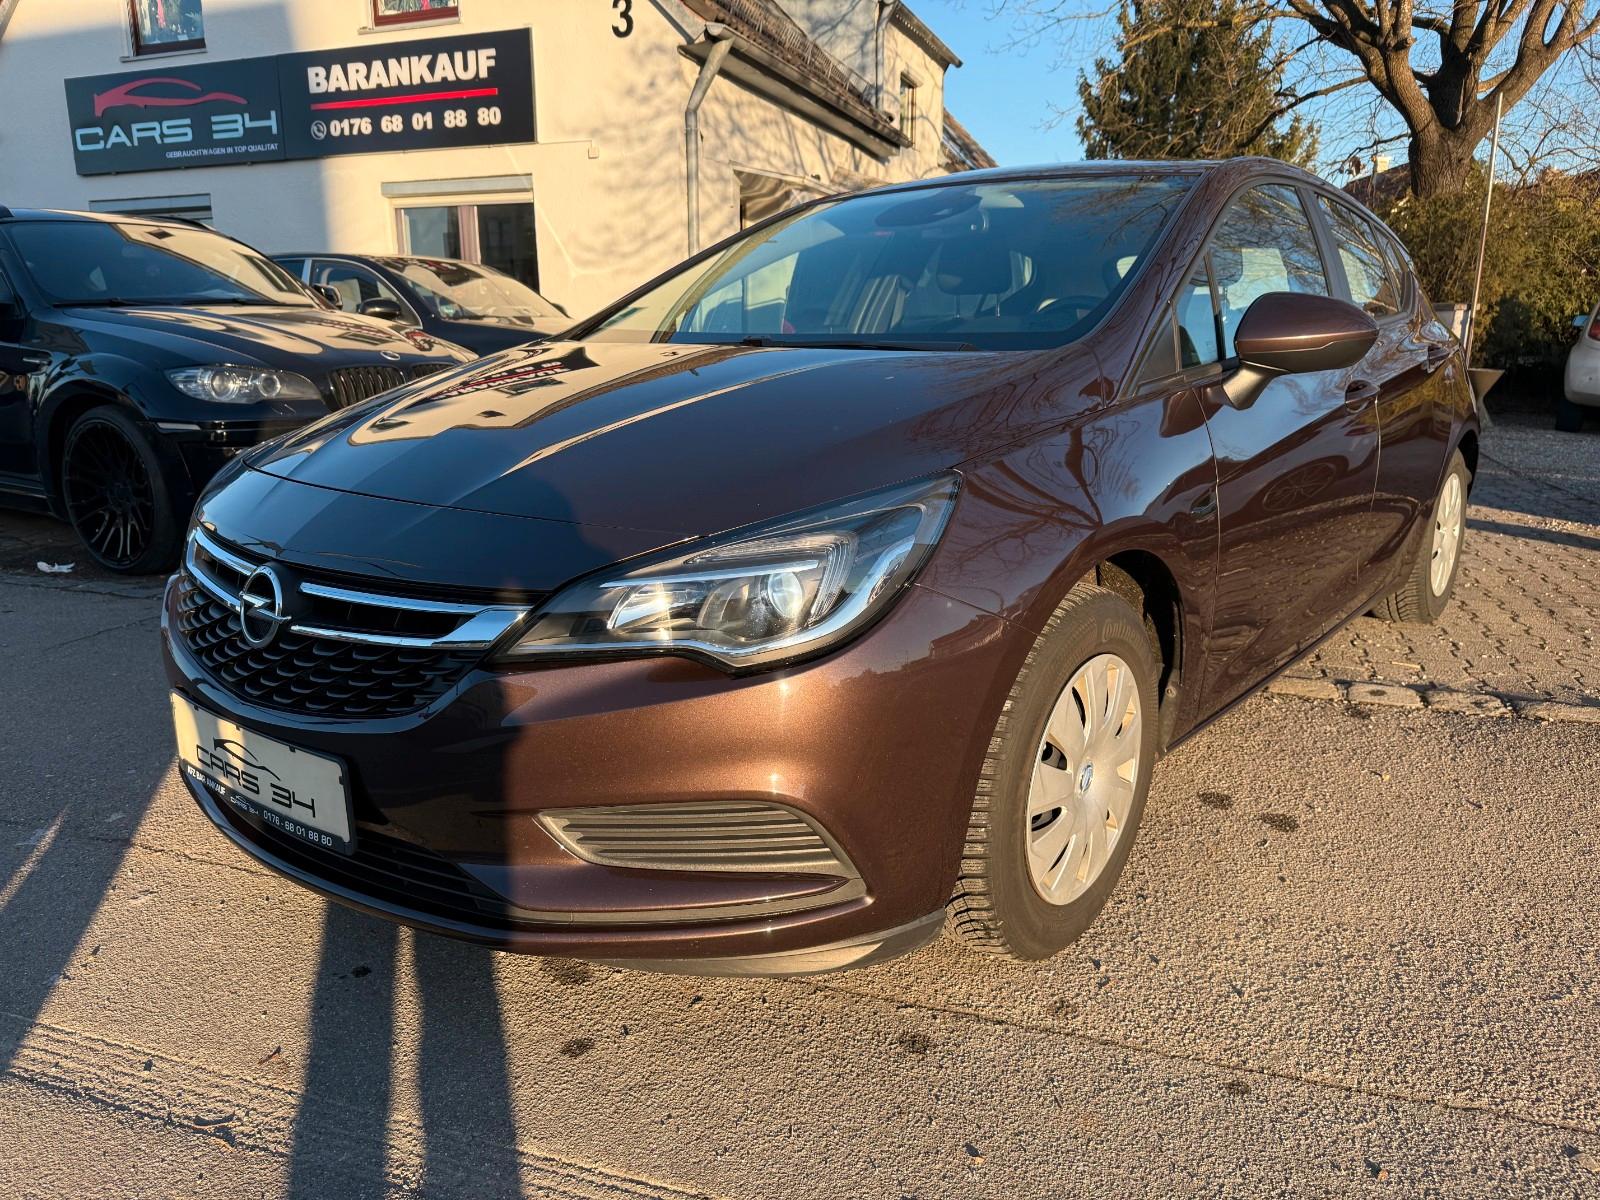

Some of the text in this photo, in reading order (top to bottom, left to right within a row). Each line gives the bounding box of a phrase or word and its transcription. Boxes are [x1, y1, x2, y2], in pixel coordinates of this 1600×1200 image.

[612, 0, 633, 38] 3
[307, 48, 496, 94] BARANKAUF
[75, 110, 278, 151] CARS 34
[329, 106, 501, 137] 0176 68 01 88 80
[165, 147, 226, 158] GEBRAUCHTWAGEN
[234, 145, 247, 153] TOP
[196, 744, 316, 818] CARS 34
[263, 810, 280, 826] 0176
[284, 820, 295, 833] 68
[296, 824, 306, 837] 01
[308, 830, 319, 842] 88
[321, 834, 333, 847] 80
